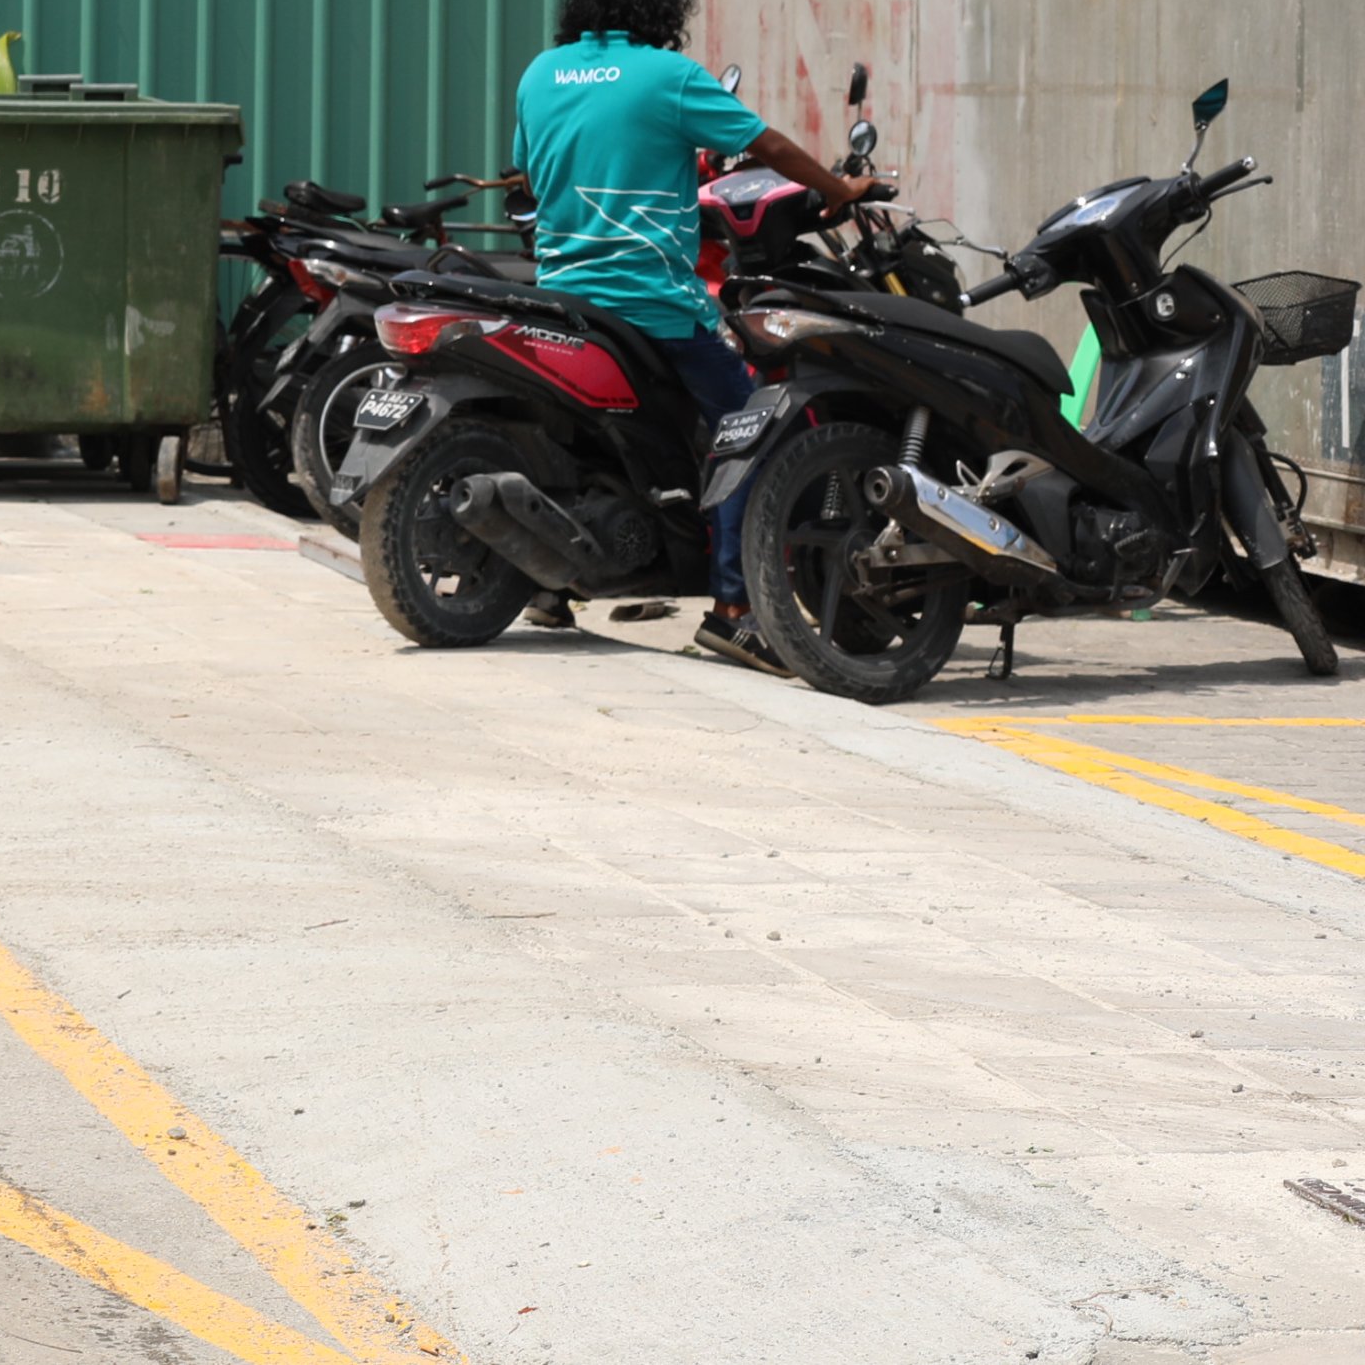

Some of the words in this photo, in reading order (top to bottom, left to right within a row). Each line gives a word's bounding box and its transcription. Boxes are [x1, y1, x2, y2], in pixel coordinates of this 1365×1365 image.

[555, 66, 621, 85] WAMCO
[15, 168, 61, 204] 10
[360, 400, 409, 419] P4672
